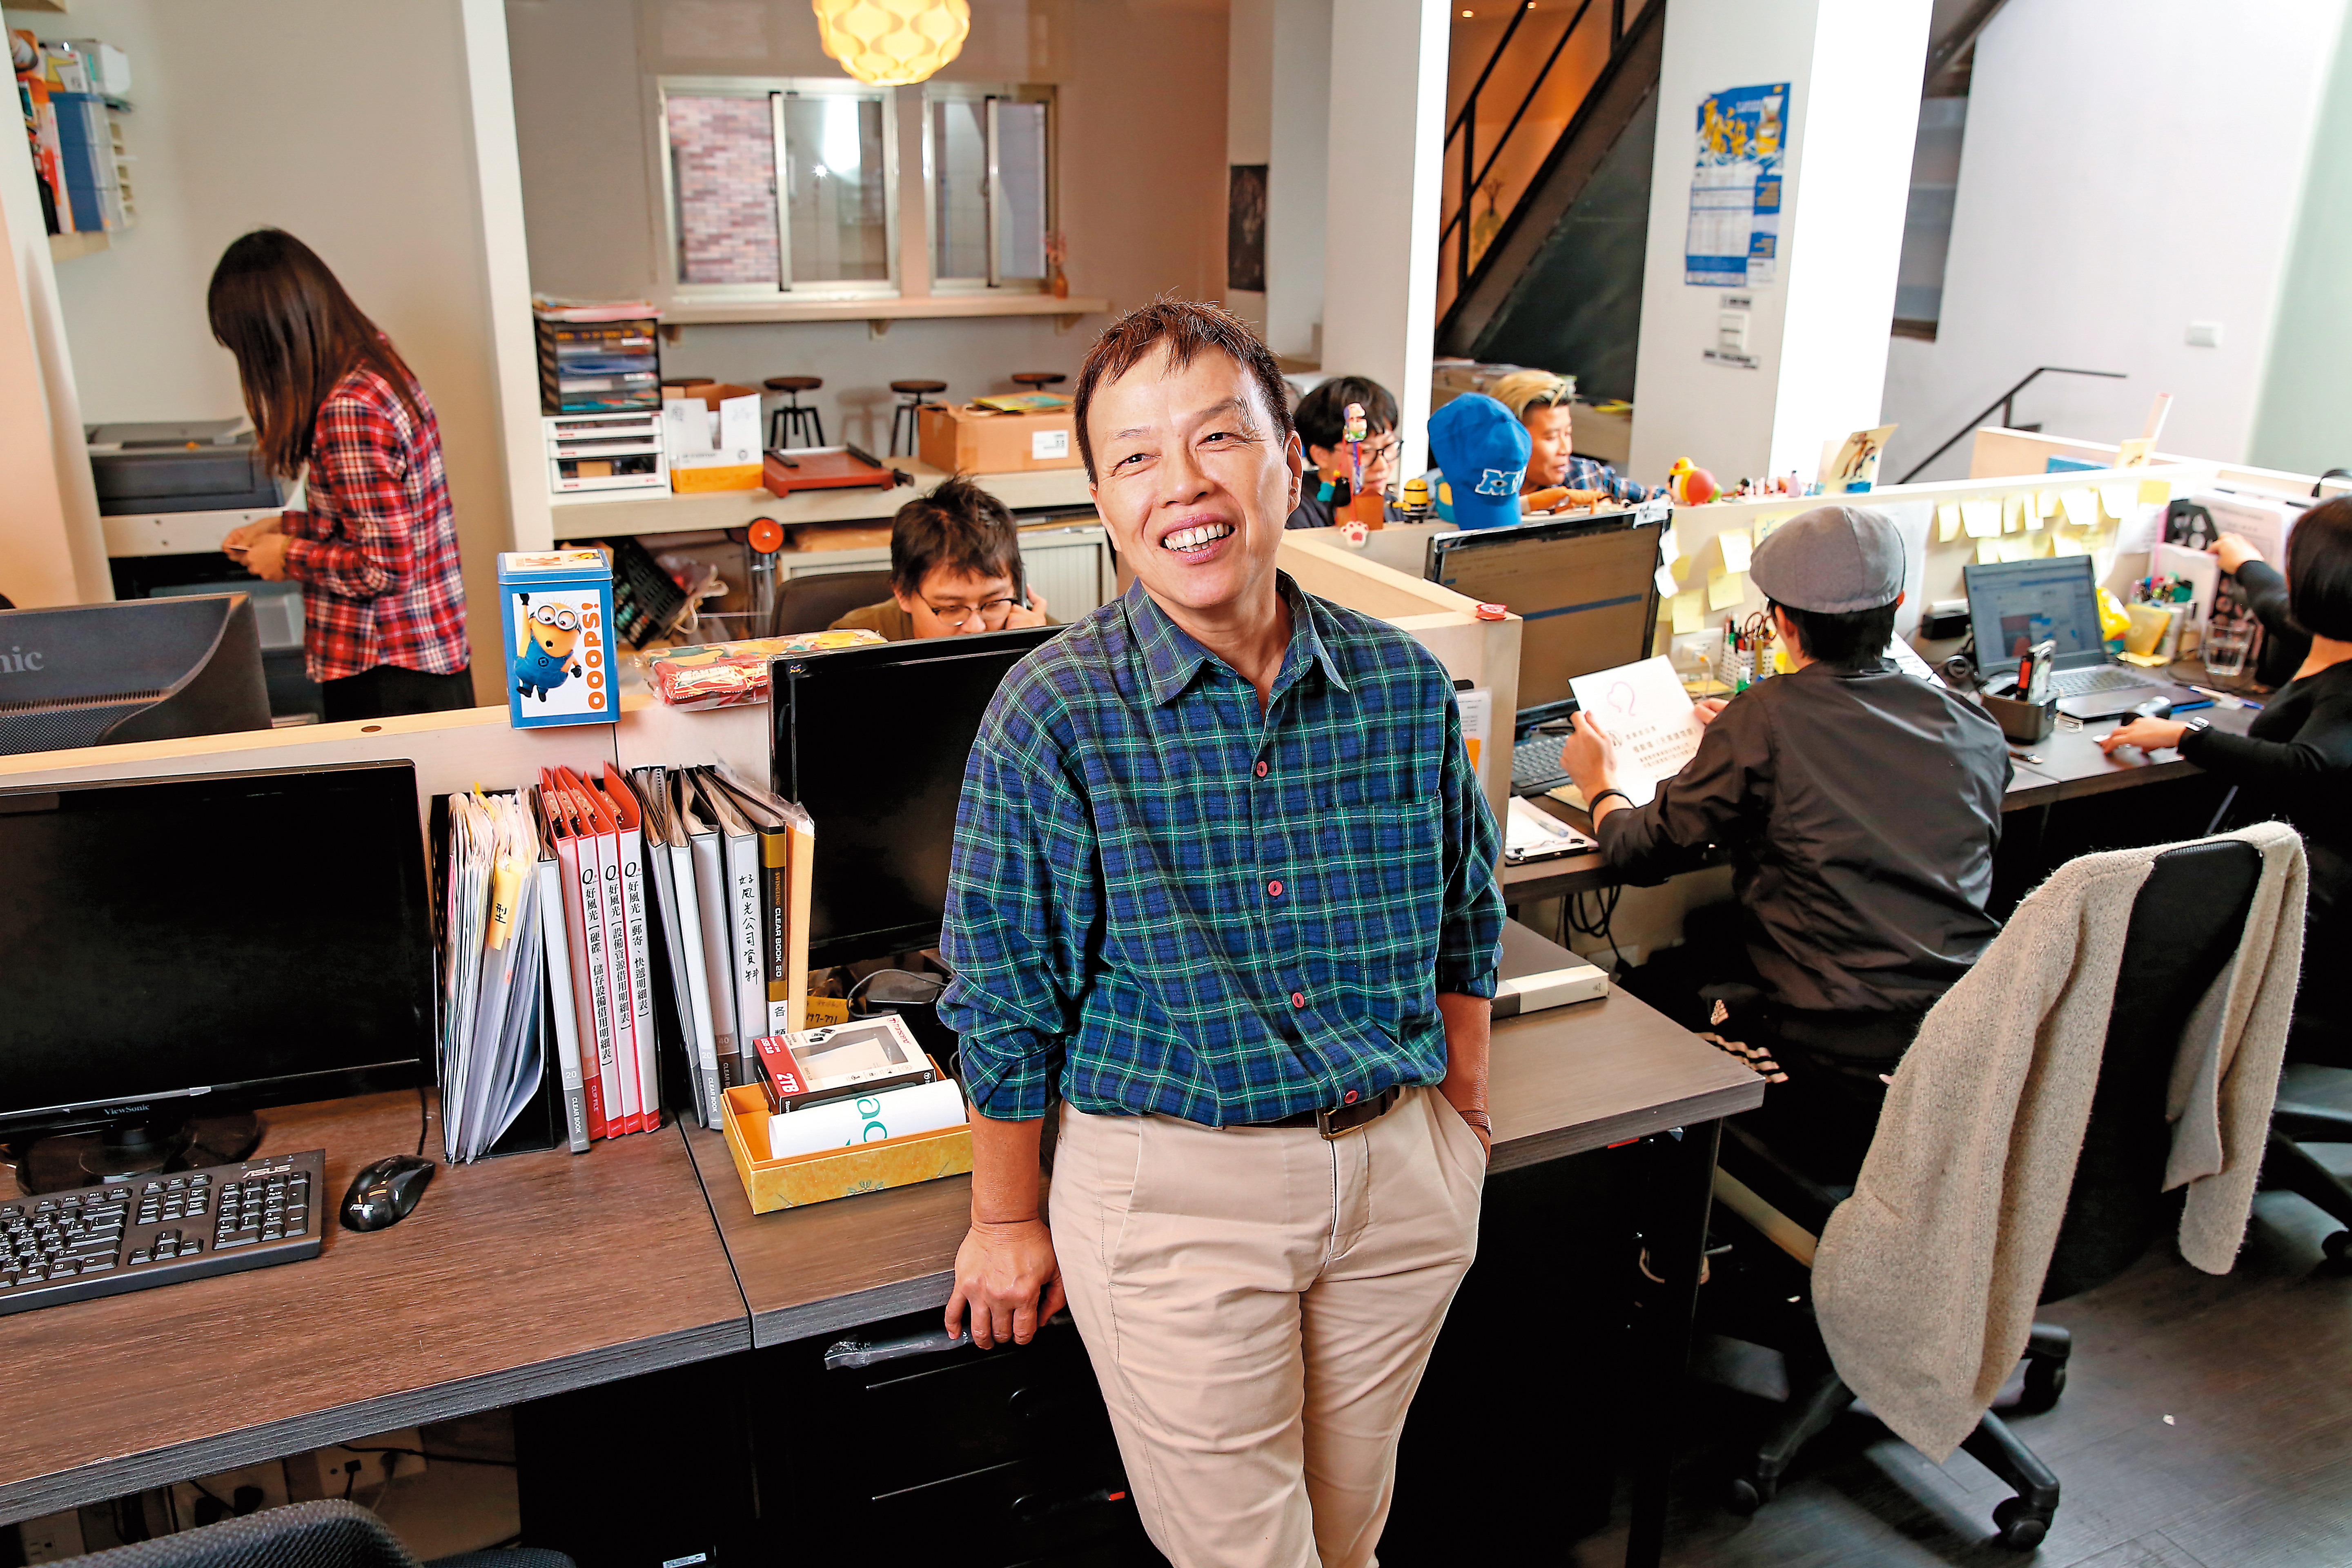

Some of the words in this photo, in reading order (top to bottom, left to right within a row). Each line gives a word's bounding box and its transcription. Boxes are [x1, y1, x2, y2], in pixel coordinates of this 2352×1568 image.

[581, 602, 605, 710] OOOPS!
[495, 902, 507, 924] 型
[775, 965, 783, 978] 20
[707, 1076, 715, 1097] CLEAR
[775, 1072, 800, 1093] 2TB
[104, 1104, 149, 1115] ViewSonic
[572, 1097, 580, 1116] CLEAR
[710, 1096, 718, 1113] BOOK
[574, 1116, 582, 1134] BOOK
[243, 1164, 291, 1179] ASUS
